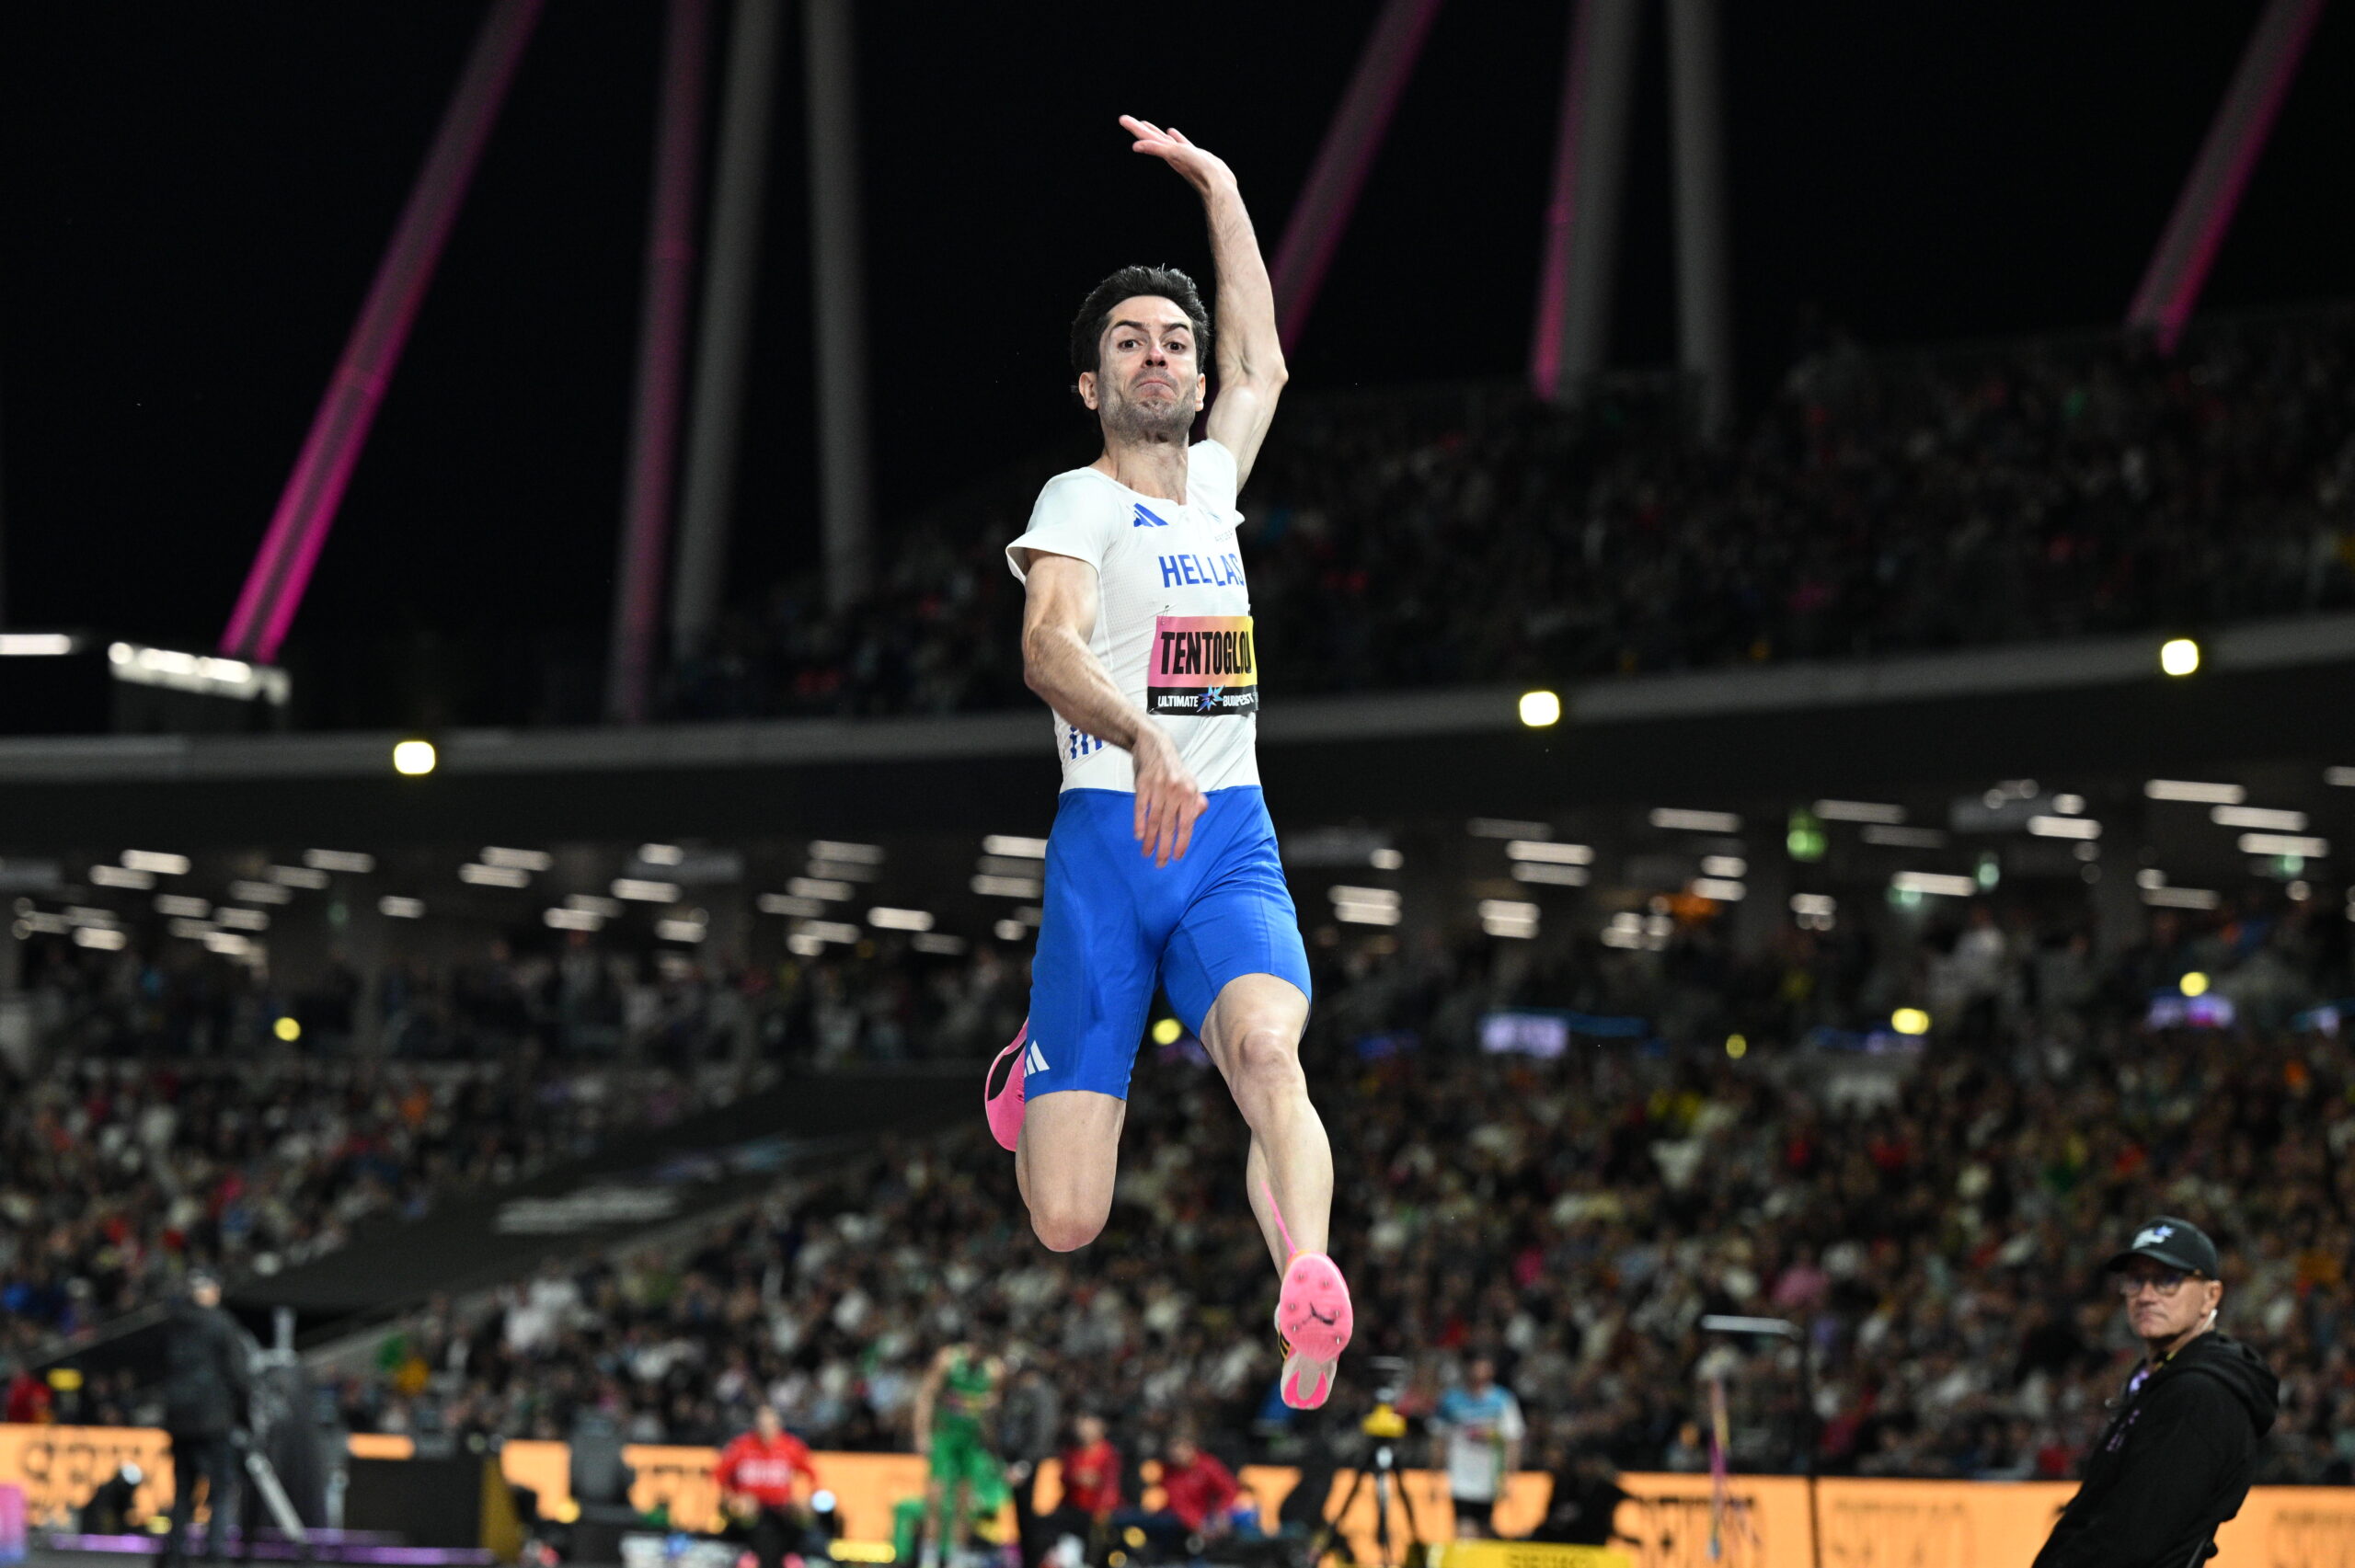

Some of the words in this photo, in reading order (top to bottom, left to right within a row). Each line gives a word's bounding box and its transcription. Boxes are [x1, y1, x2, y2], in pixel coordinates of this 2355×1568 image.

[1158, 554, 1245, 588] HELLAS
[1160, 631, 1252, 675] TENTOGLOU
[1157, 695, 1199, 707] ULTIMATE
